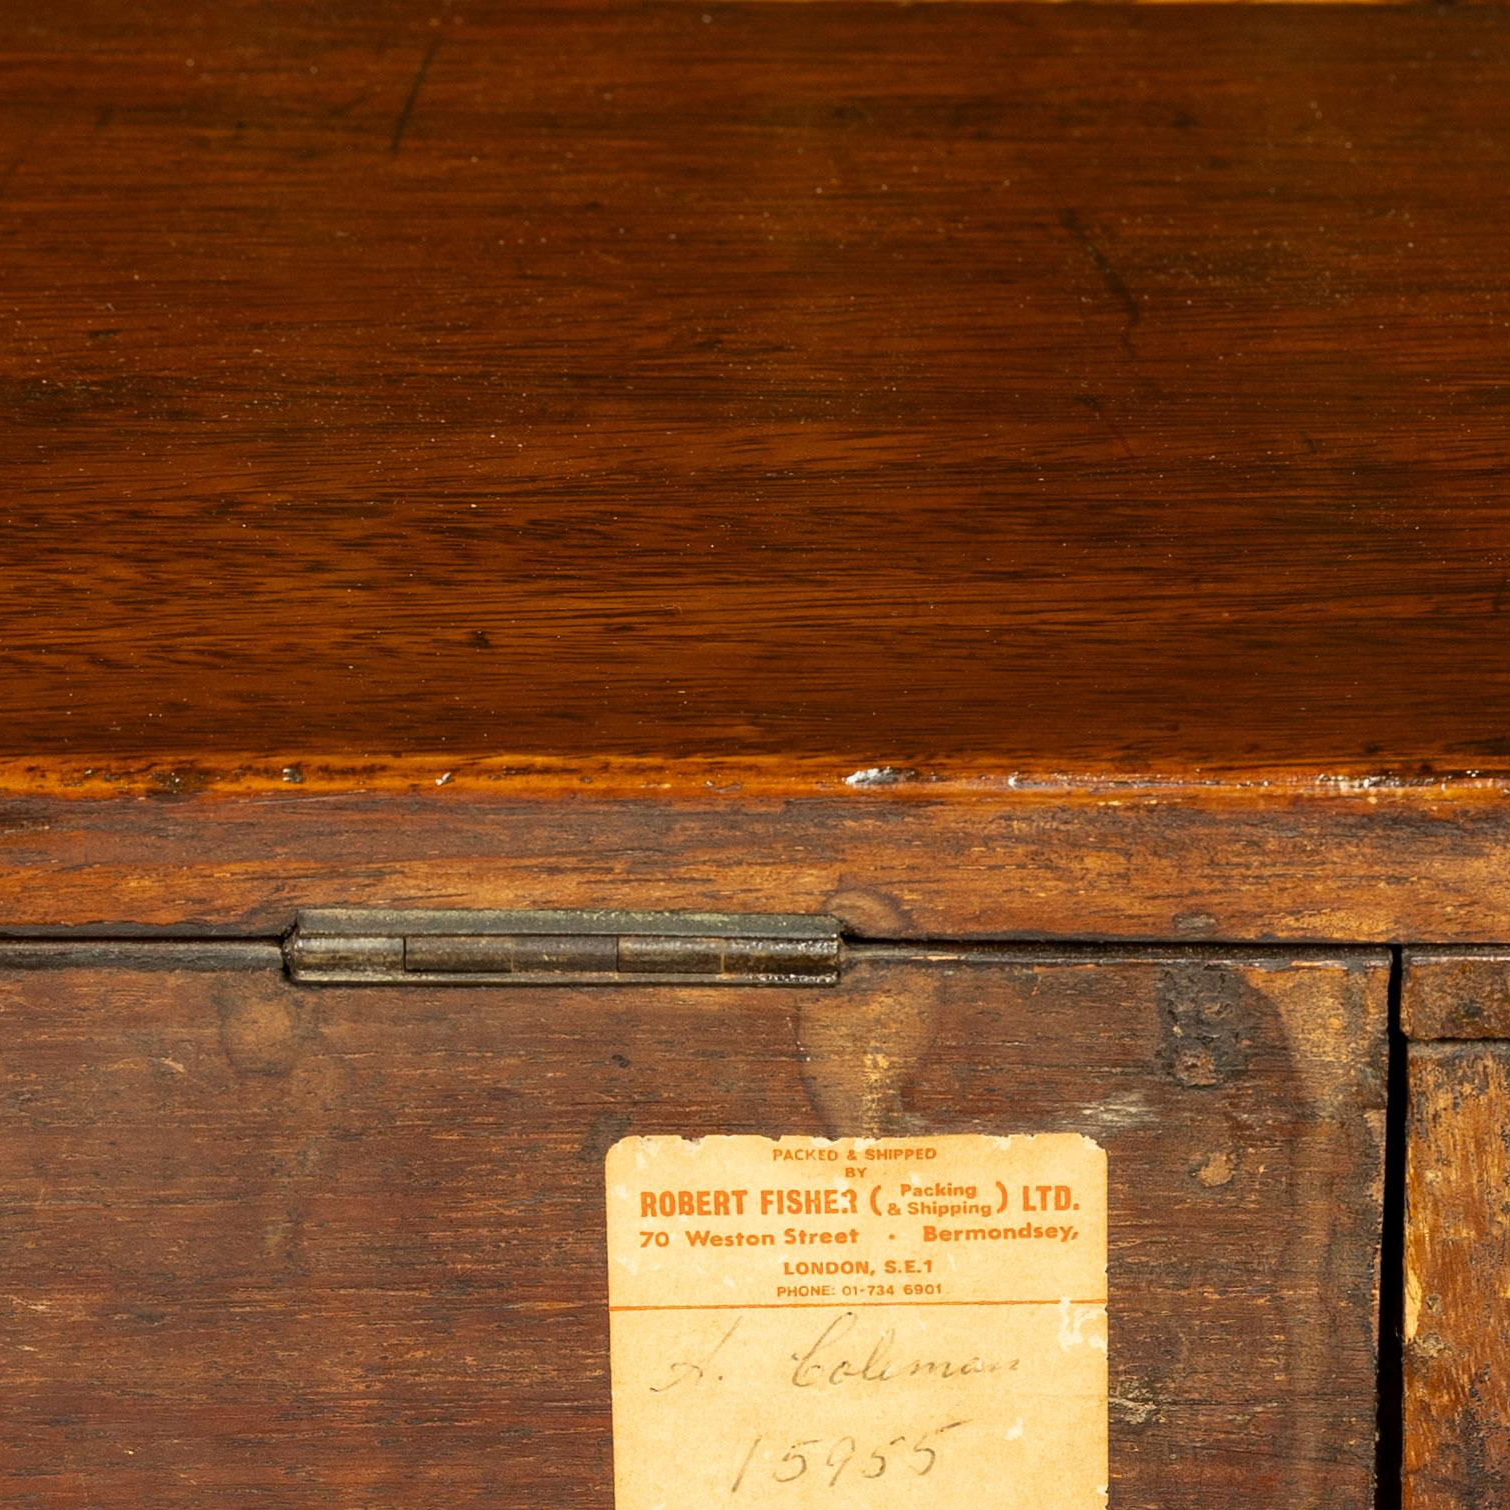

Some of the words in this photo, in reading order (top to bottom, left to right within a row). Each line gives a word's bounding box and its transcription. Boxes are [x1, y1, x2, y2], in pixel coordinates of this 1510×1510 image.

[773, 1148, 838, 1161] PACKED
[846, 1148, 858, 1161] &
[864, 1148, 937, 1161] SHIPPED
[845, 1167, 867, 1178] BY
[900, 1183, 977, 1199] Packing
[1022, 1184, 1080, 1212] LTD.
[640, 1189, 748, 1217] ROBERT
[887, 1203, 901, 1216] &
[907, 1201, 992, 1217] Shipping
[639, 1231, 670, 1248] 70
[685, 1230, 776, 1247] Weston
[784, 1228, 860, 1245] Street
[922, 1222, 1079, 1243] Bermondsey,
[783, 1261, 876, 1277] LONDON,
[884, 1260, 933, 1274] S.E.1
[777, 1285, 835, 1297] PHONE:
[842, 1284, 895, 1296] 01-734
[903, 1283, 942, 1296] 6901
